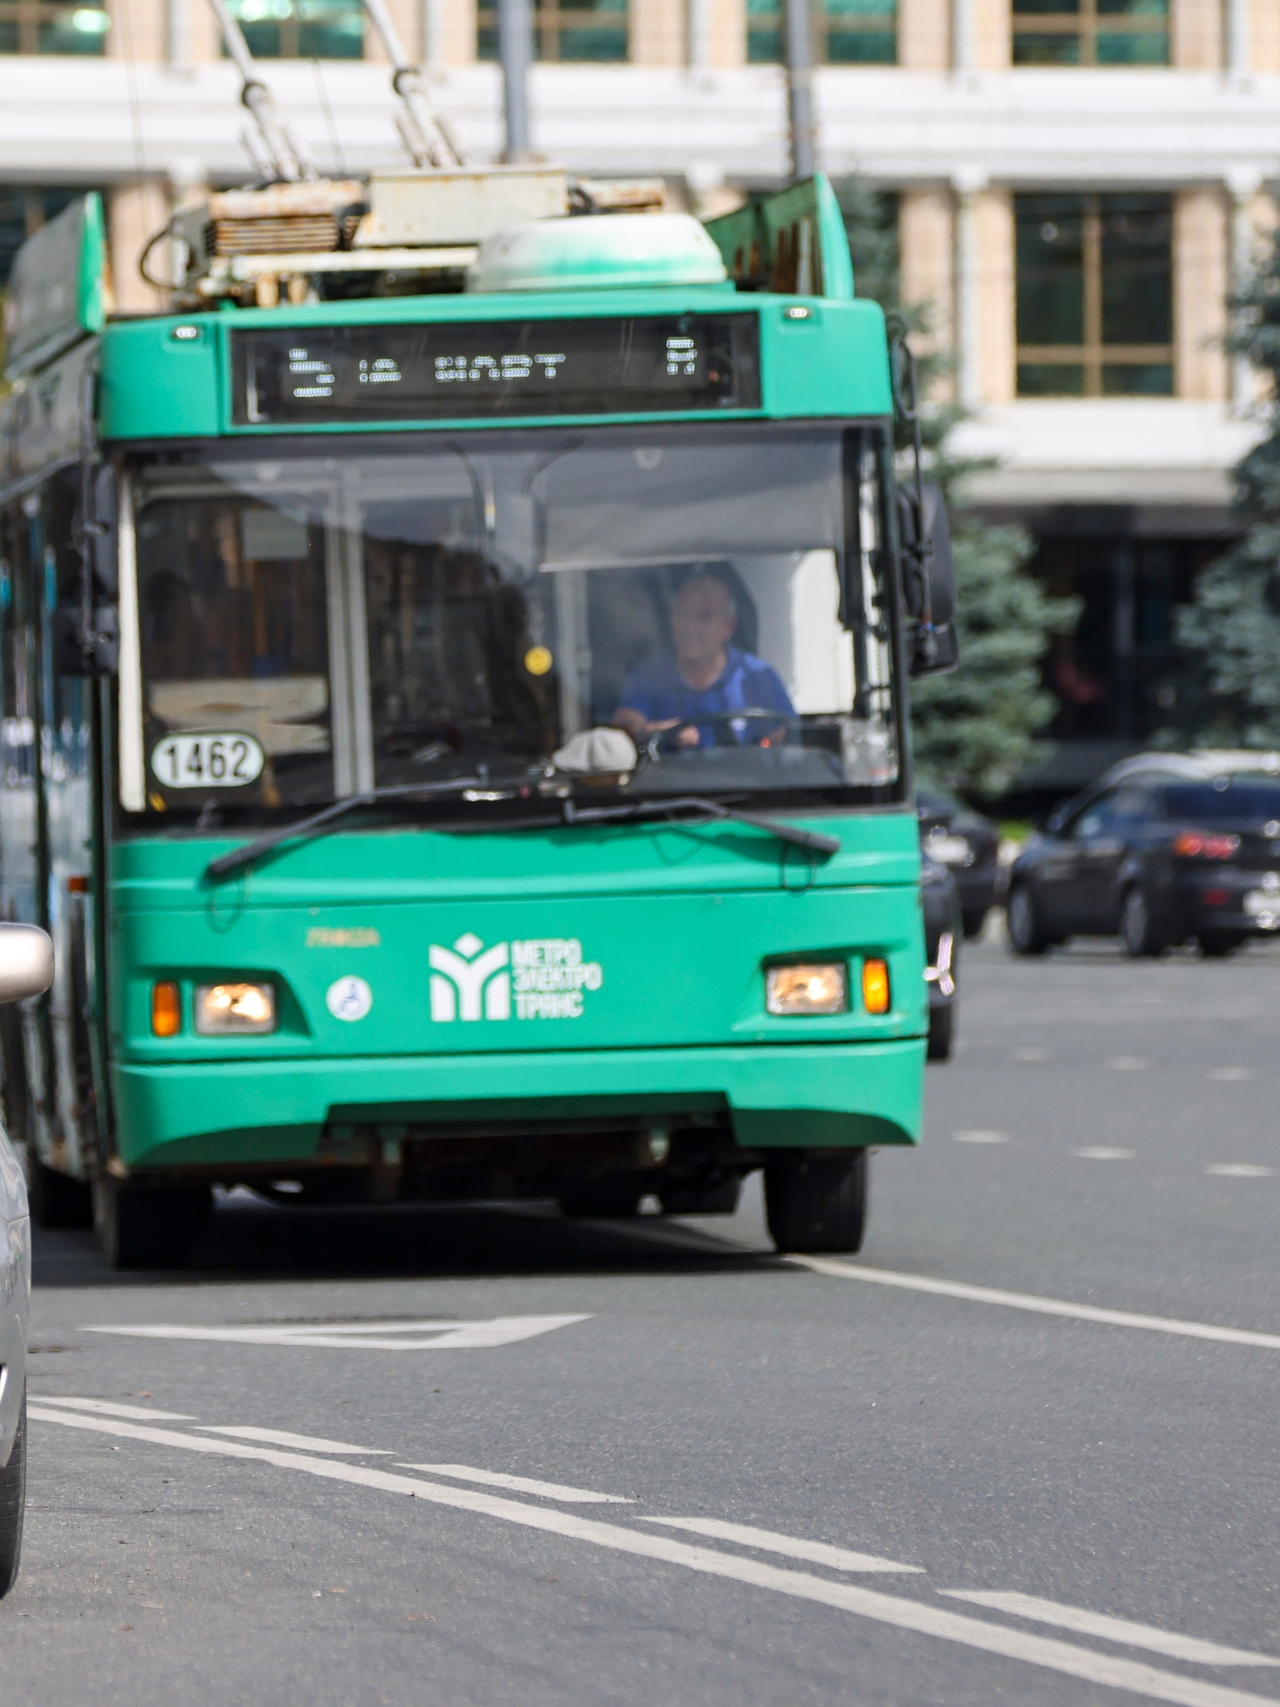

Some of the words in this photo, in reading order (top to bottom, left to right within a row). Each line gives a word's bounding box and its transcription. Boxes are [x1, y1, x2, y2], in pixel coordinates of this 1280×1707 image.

[165, 740, 248, 780] 1462
[510, 938, 582, 966] МЕТРО
[512, 962, 603, 991] ЭЛЕКТРО
